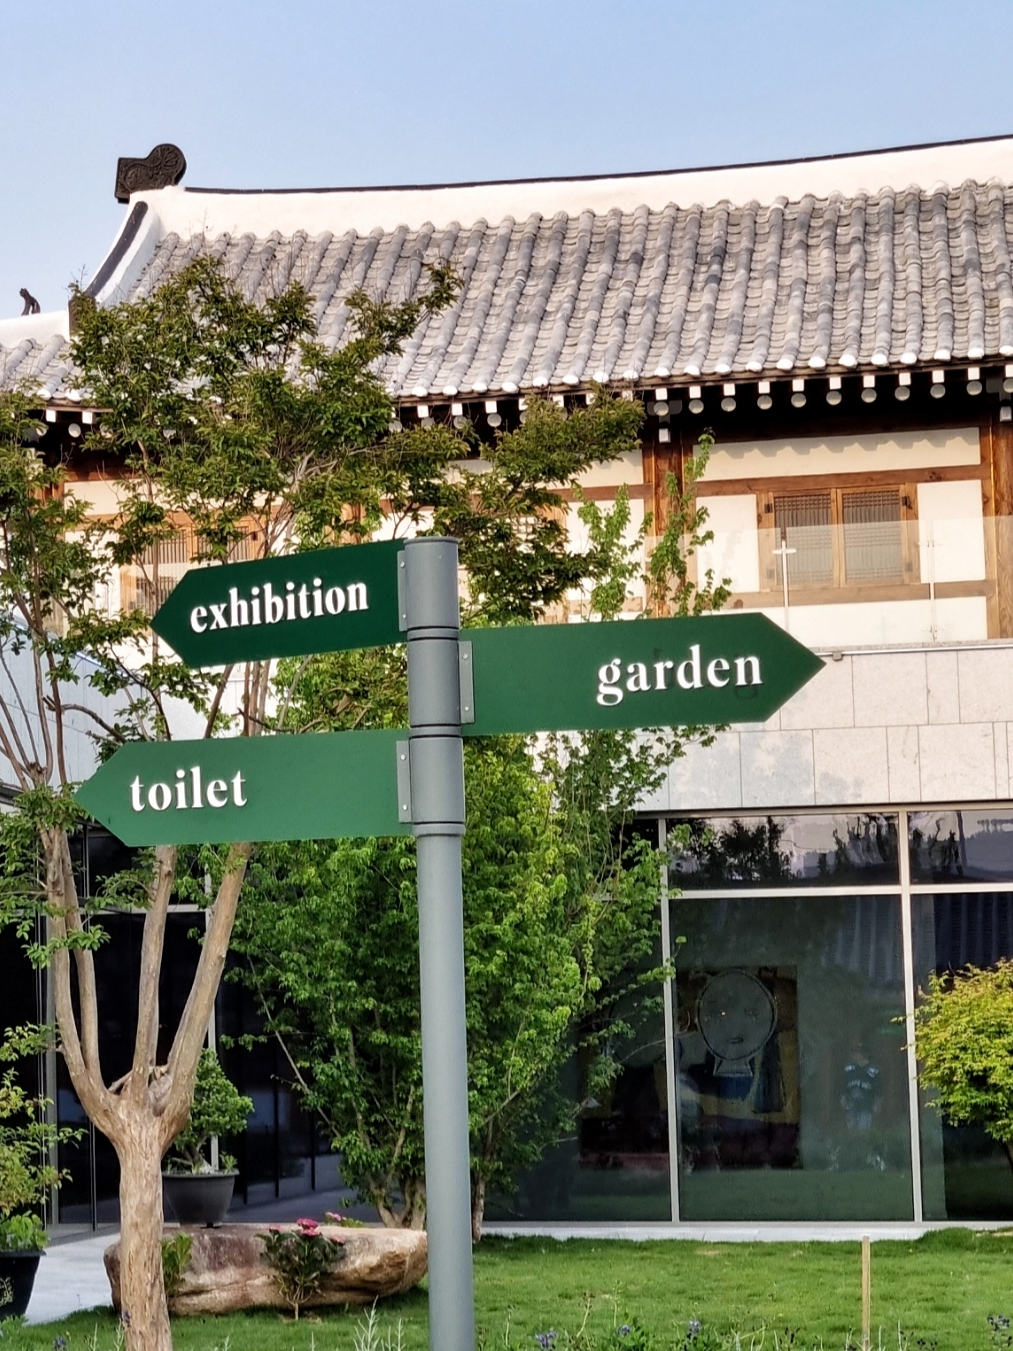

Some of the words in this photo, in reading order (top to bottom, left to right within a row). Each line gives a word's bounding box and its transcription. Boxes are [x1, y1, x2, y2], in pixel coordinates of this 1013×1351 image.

[190, 577, 369, 633] exhibition
[596, 645, 763, 706] garden
[130, 766, 247, 812] toilet
